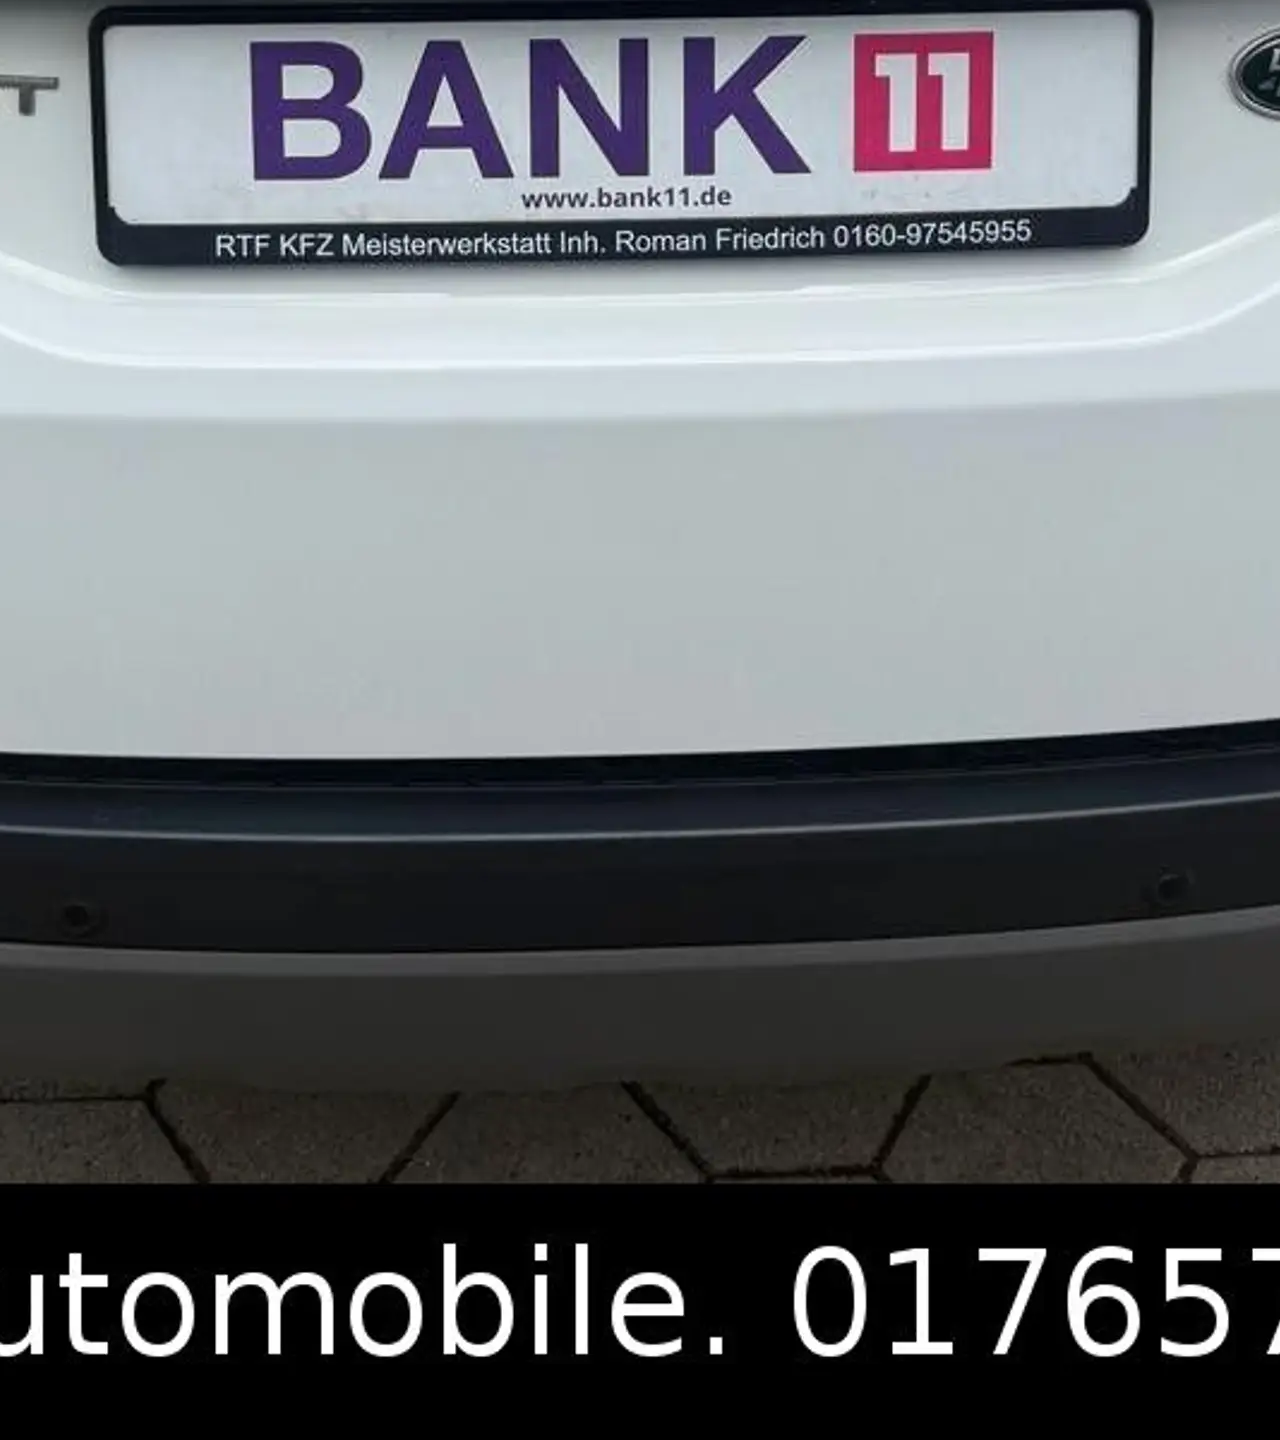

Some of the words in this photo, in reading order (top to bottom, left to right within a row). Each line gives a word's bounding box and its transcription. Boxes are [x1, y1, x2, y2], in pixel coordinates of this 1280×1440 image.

[248, 35, 811, 181] BANK
[870, 48, 974, 157] 11
[521, 186, 733, 208] www.bank11.de
[215, 233, 270, 258] RTF
[279, 232, 335, 257] KFZ
[341, 231, 552, 257] Meisterwerkstatt
[559, 229, 607, 255] Inh.
[614, 228, 707, 254] Roman
[715, 225, 825, 252] Friedrich
[833, 218, 1033, 248] 0160-97545955
